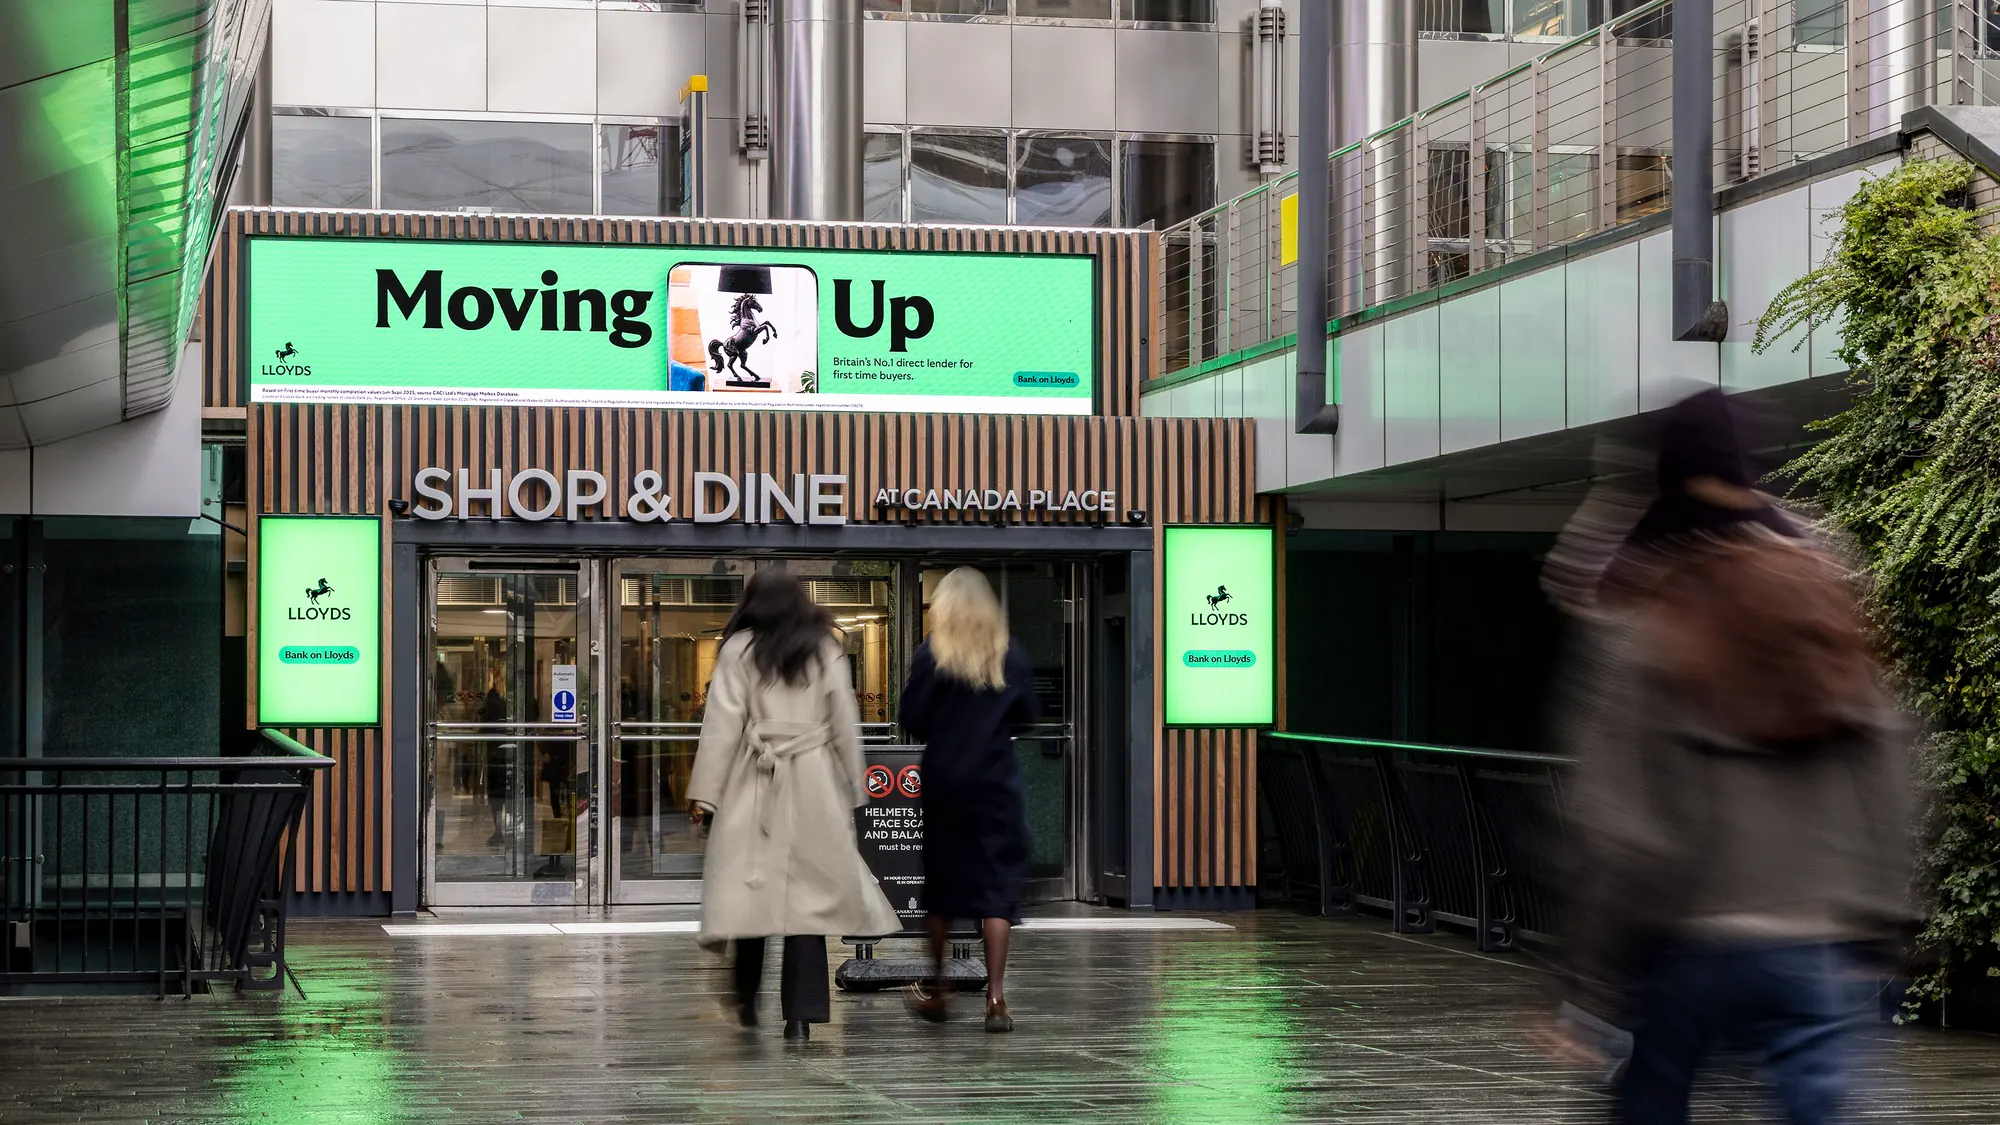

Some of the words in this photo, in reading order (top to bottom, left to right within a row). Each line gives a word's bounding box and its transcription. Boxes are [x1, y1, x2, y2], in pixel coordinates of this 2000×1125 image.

[375, 269, 654, 348] Moving
[832, 279, 935, 352] Up
[833, 357, 871, 367] Britain's
[874, 358, 894, 367] No.1
[896, 358, 925, 368] direct
[927, 359, 957, 368] lender
[959, 359, 973, 369] for
[262, 365, 312, 376] LLOYDS
[833, 370, 853, 380] first
[855, 371, 878, 380] time
[880, 371, 914, 382] buyers.
[1017, 375, 1037, 384] Bank
[1050, 376, 1075, 385] Lloyds
[412, 467, 607, 522] SHOP
[627, 469, 673, 523] &
[693, 472, 847, 525] DINE
[875, 488, 899, 506] AT
[903, 488, 1022, 511] CANADA
[1029, 490, 1116, 512] PLACE
[288, 607, 351, 620] LLOYDS
[1191, 613, 1248, 626] LLOYDS
[285, 650, 308, 659] Bank
[324, 650, 354, 661] Lloyds
[1188, 654, 1209, 663] Bank
[1224, 655, 1251, 665] Lloyds
[865, 808, 917, 818] HELMETS,
[873, 819, 901, 828] FACE
[903, 819, 924, 828] SCA
[864, 830, 888, 839] AND
[891, 830, 924, 839] BALA
[900, 843, 911, 851] be
